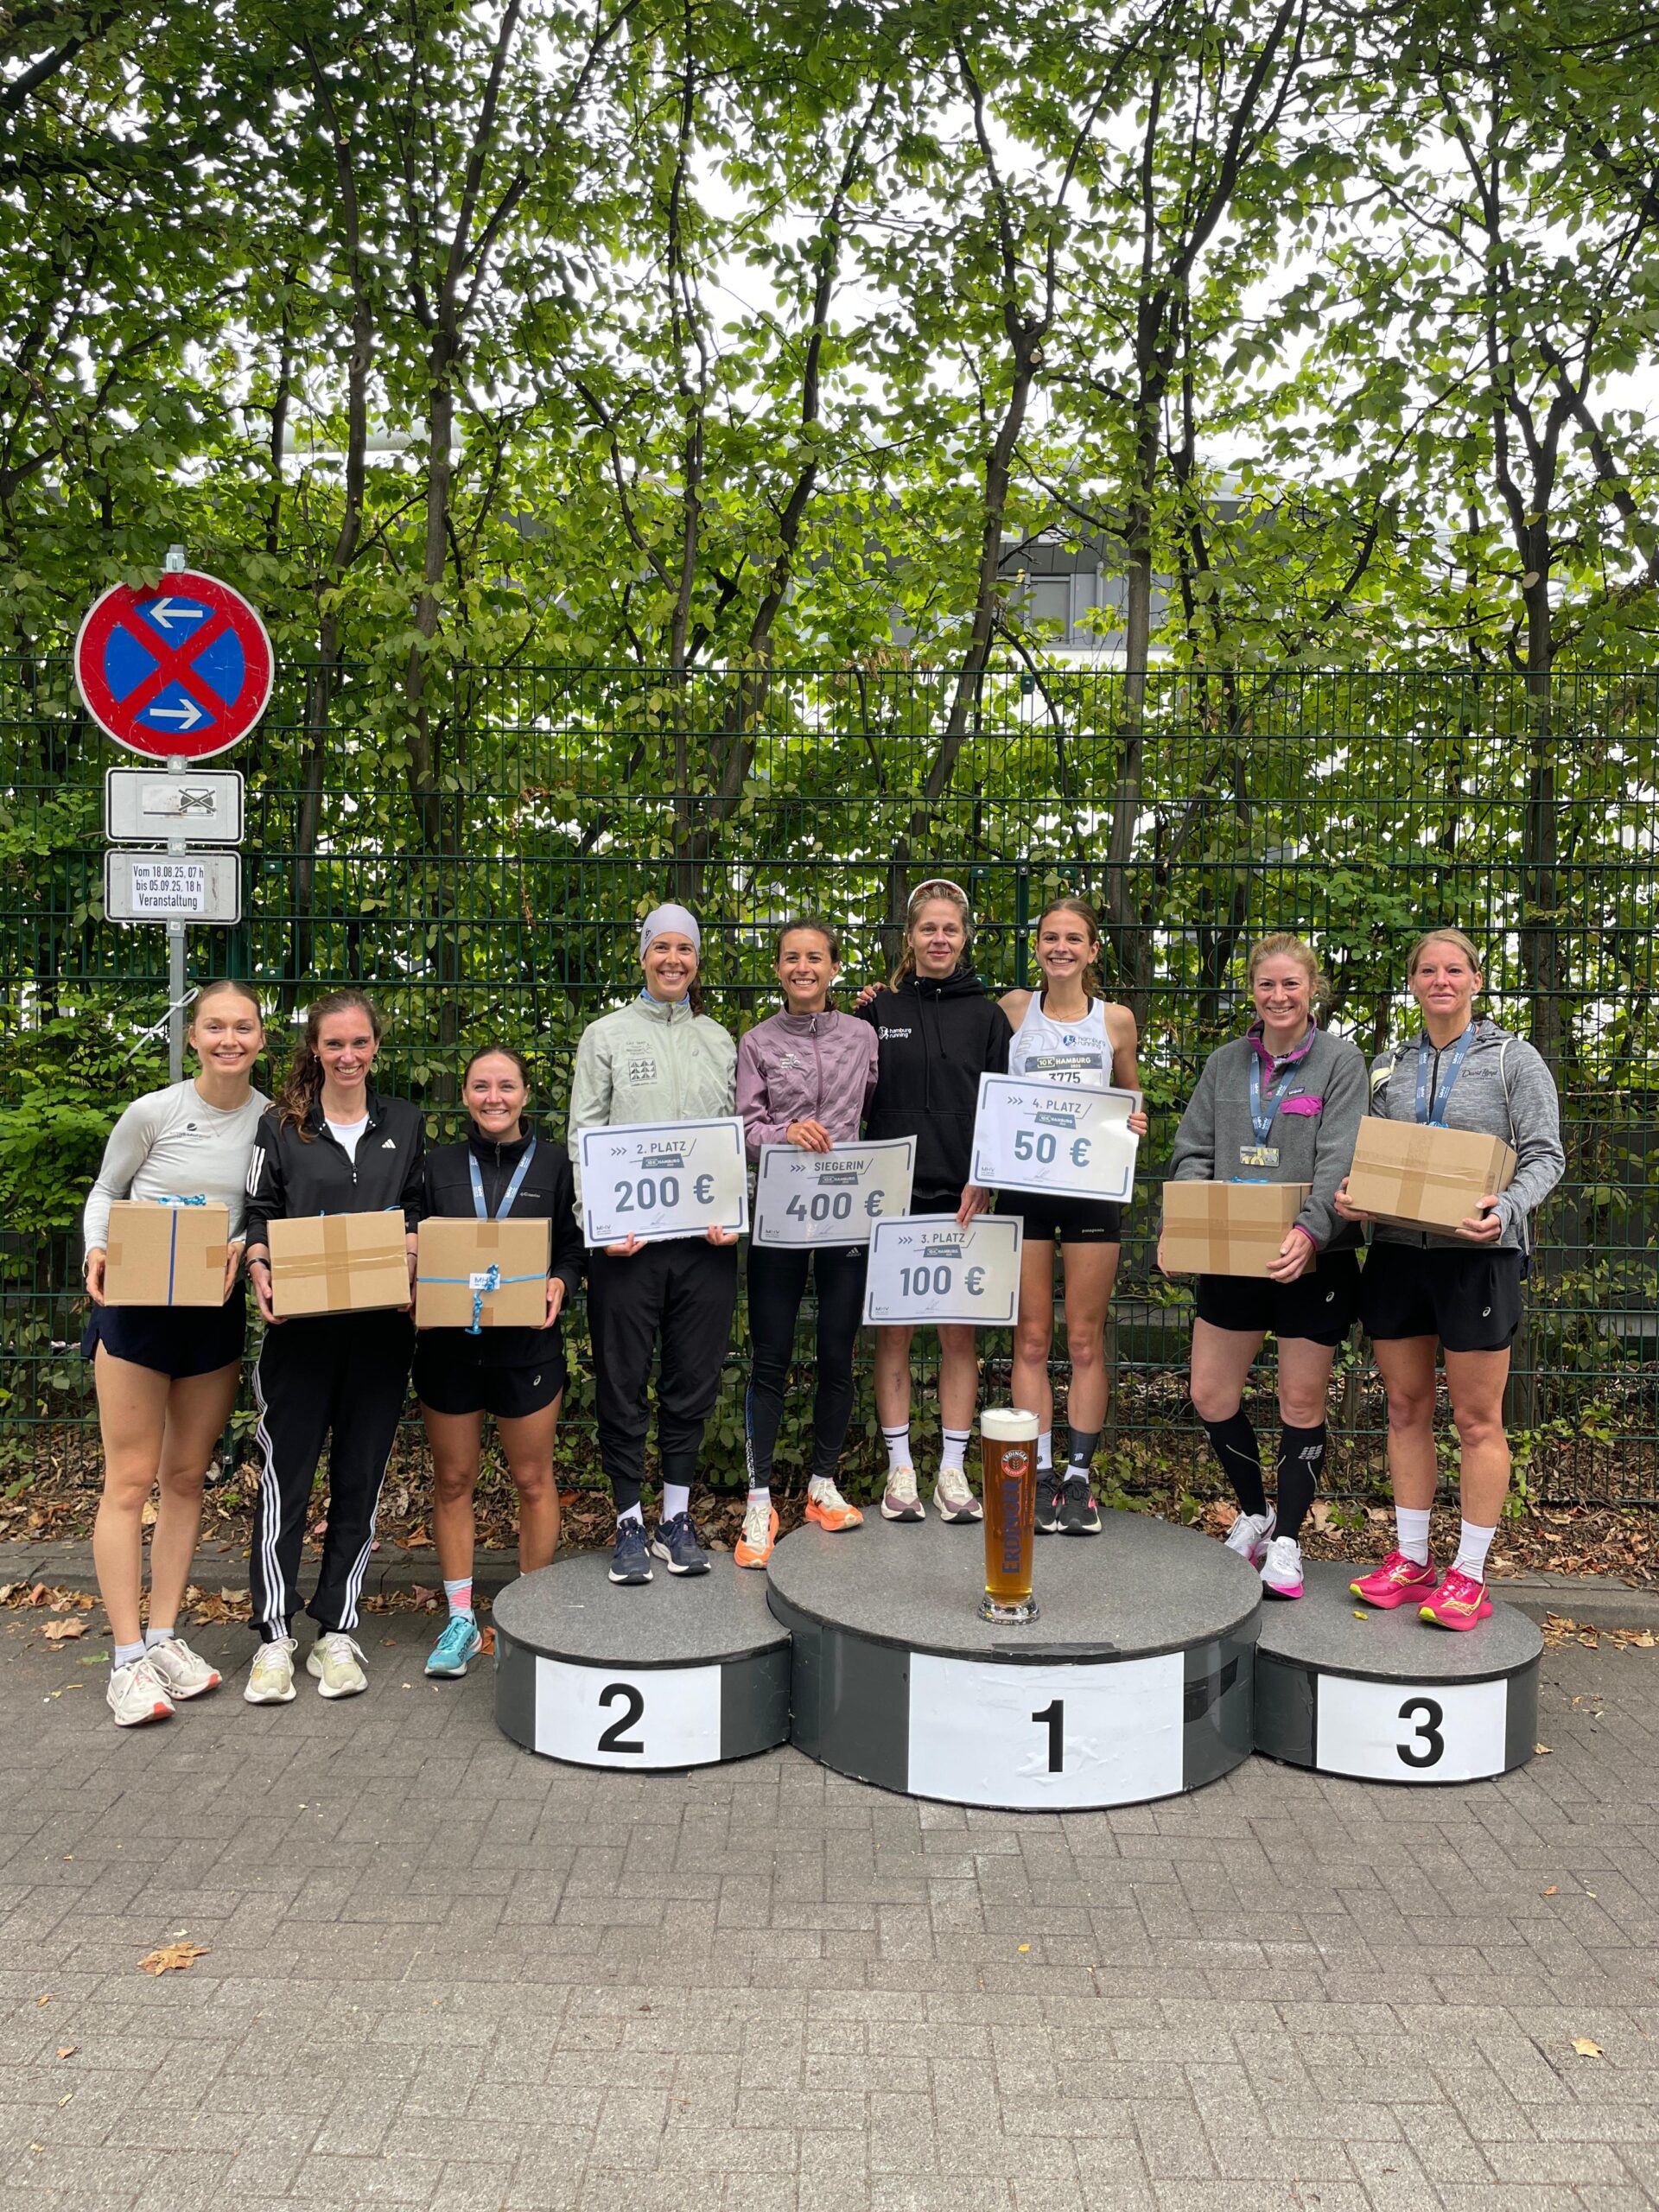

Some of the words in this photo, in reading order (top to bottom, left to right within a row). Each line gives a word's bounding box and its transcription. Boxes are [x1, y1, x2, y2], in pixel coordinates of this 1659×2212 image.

[133, 866, 149, 877] Vom
[153, 866, 186, 879] 18.08.25,
[188, 867, 197, 878] 07
[200, 868, 204, 878] h
[136, 880, 148, 891] bis
[149, 880, 183, 892] 05.09.25,
[186, 880, 194, 892] 18
[196, 881, 201, 892] h
[139, 893, 198, 910] Veranstaltung
[1049, 1071, 1081, 1084] 3775
[1033, 1098, 1043, 1109] 4.
[1046, 1100, 1082, 1113] PLATZ
[637, 1143, 647, 1154] 2.
[651, 1141, 687, 1154] PLATZ
[1014, 1129, 1057, 1164] 50
[1069, 1137, 1092, 1167] €
[814, 1160, 864, 1172] SIEGERIN
[614, 1176, 680, 1213] 200
[693, 1173, 715, 1205] €
[785, 1192, 852, 1222] 400
[864, 1190, 885, 1217] €
[921, 1235, 930, 1243] 3.
[932, 1233, 965, 1243] PLATZ
[899, 1265, 952, 1297] 100
[964, 1266, 986, 1295] €
[1002, 1478, 1022, 1573] ERDINGER
[597, 1682, 645, 1754] 2
[1032, 1699, 1064, 1773] 1
[1395, 1696, 1445, 1769] 3
